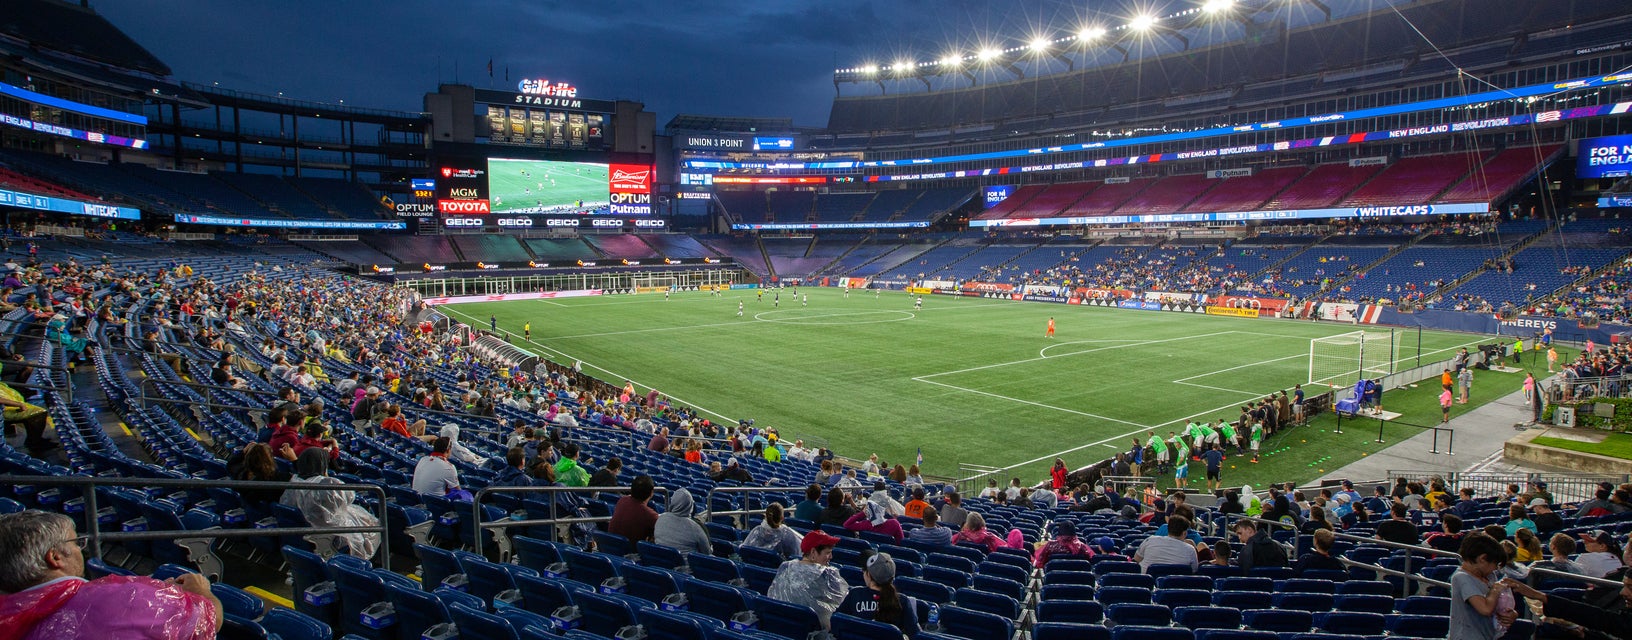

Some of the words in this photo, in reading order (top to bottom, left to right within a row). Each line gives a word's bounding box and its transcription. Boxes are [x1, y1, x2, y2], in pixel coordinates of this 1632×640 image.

[518, 79, 577, 98] Gillette
[516, 96, 581, 108] STADIUM
[1389, 130, 1408, 138] NEW
[1408, 125, 1448, 136] ENGLAND
[1452, 118, 1509, 131] REVOLUTION
[720, 139, 743, 147] POINT
[1220, 146, 1257, 155] REVOLUTION
[1590, 146, 1618, 156] FOR
[450, 188, 477, 196] MGM
[610, 193, 650, 204] OPTUM
[84, 203, 118, 218] WHITECAPS
[396, 203, 434, 212] OPTUM
[441, 202, 488, 211] TOYOTA
[610, 204, 650, 214] Putnam
[1359, 204, 1428, 216] WHITECAPS
[1208, 306, 1238, 314] Continental
